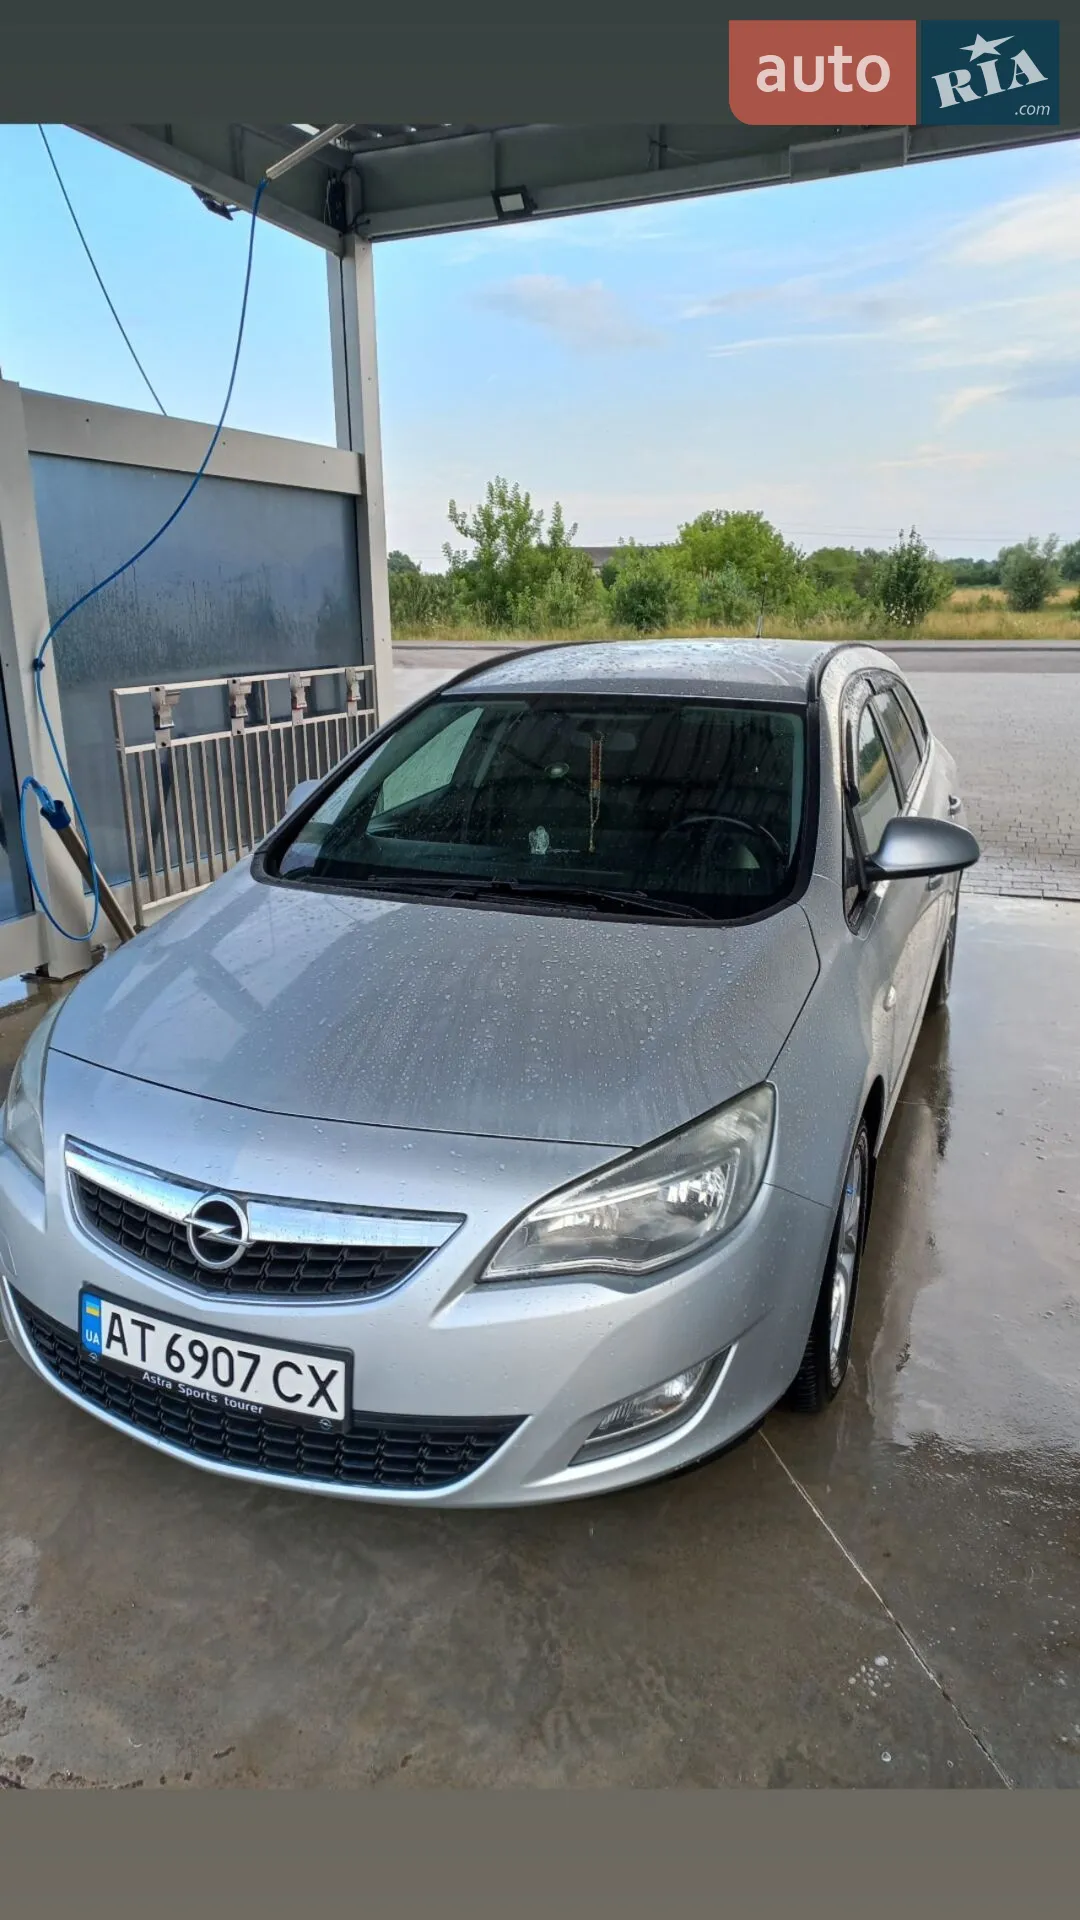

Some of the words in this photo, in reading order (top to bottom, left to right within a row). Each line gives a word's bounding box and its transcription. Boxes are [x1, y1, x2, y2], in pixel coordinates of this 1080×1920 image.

[85, 1329, 100, 1346] UA
[105, 1311, 156, 1363] AT
[164, 1332, 261, 1394] 6907
[272, 1360, 339, 1413] CX
[142, 1371, 172, 1390] Astra
[177, 1383, 218, 1404] Sports
[224, 1396, 263, 1414] tourer
